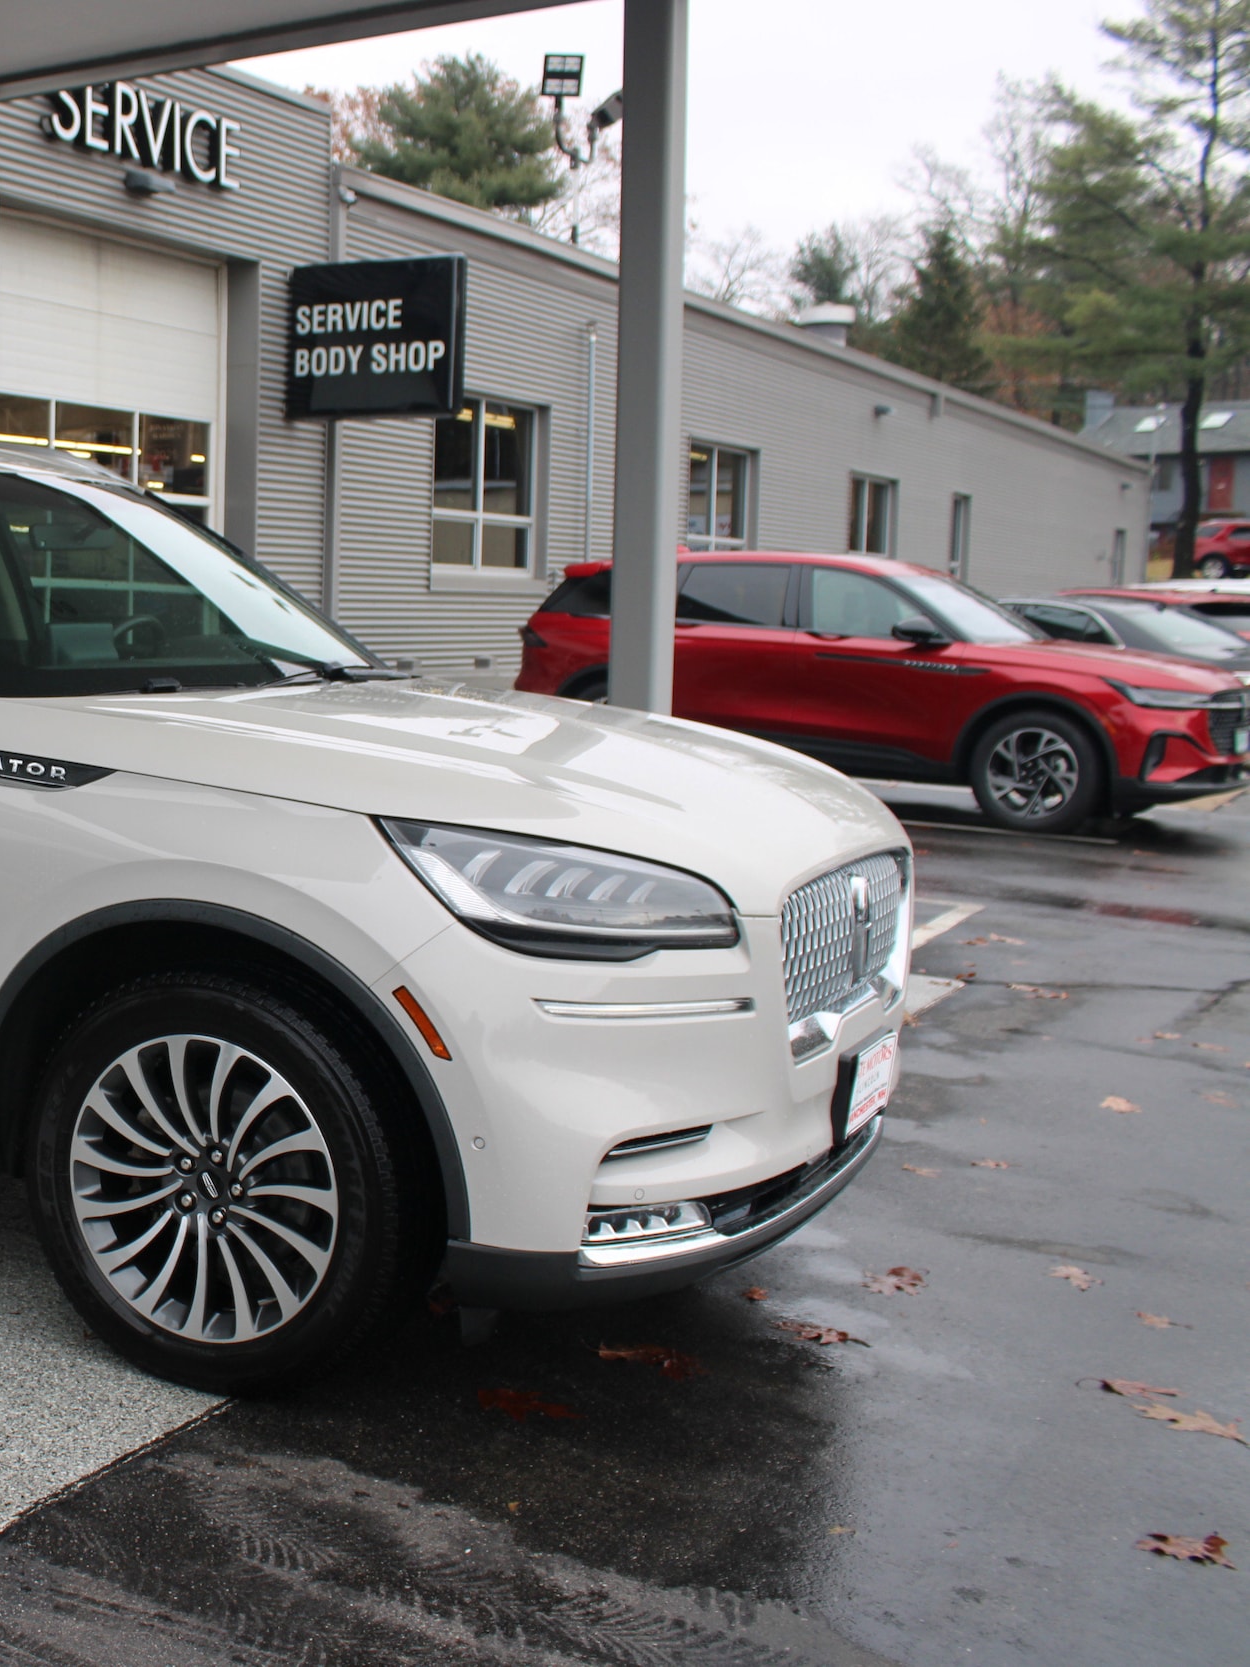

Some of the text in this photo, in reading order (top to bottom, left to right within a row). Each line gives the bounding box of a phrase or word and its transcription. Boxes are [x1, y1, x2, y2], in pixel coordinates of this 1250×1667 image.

[51, 80, 242, 190] SERVICE
[296, 298, 404, 336] SERVICE
[294, 339, 446, 378] BODY SHOP
